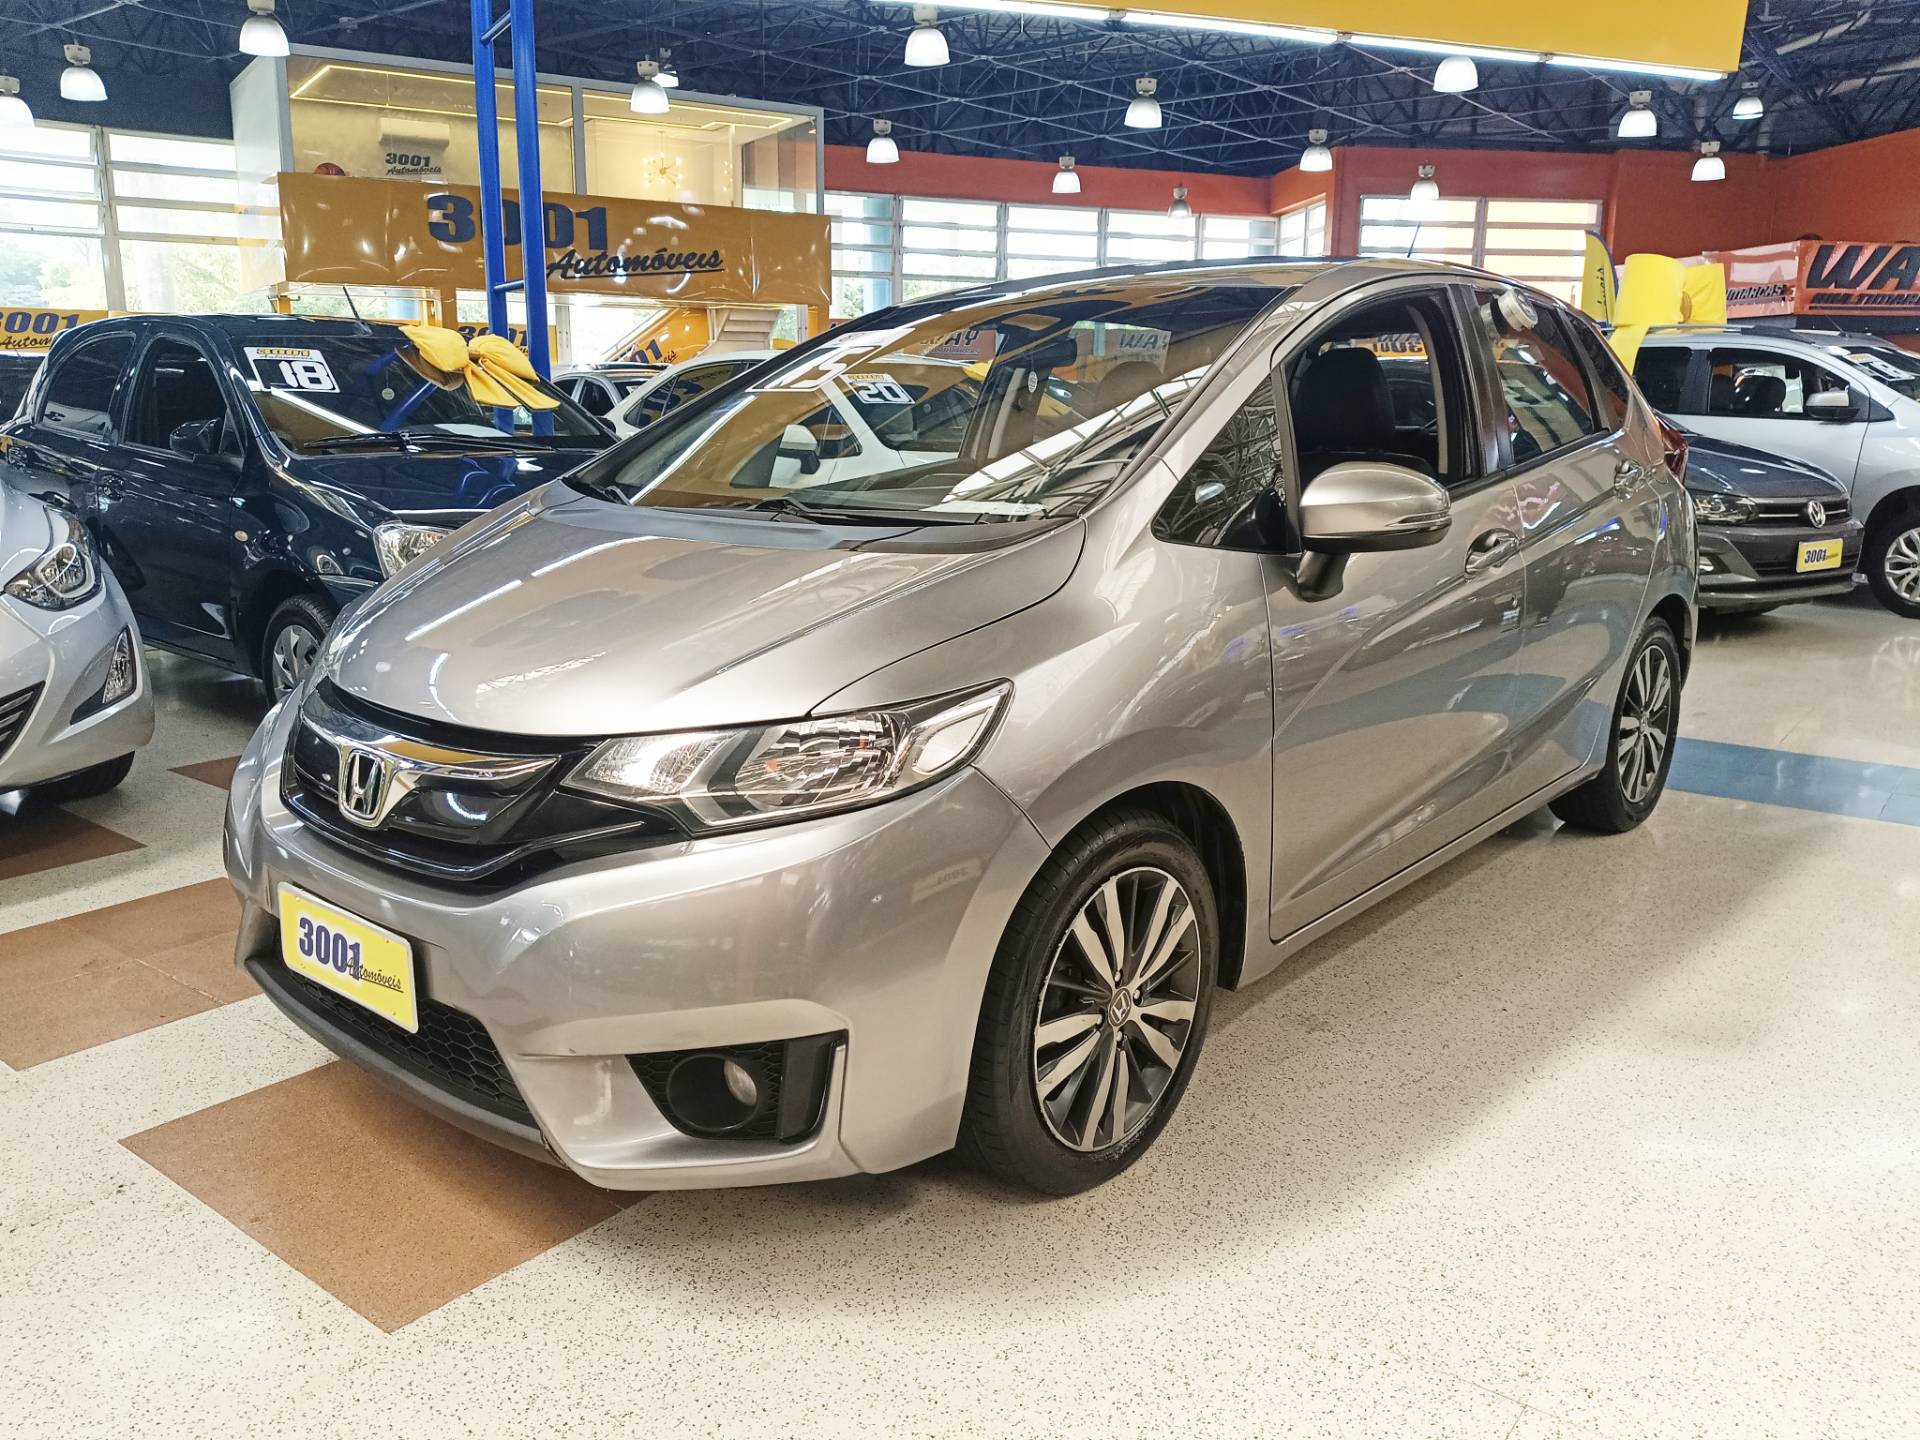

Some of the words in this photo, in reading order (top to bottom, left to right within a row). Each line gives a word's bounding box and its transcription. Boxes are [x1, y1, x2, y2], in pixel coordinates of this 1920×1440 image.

[385, 152, 431, 168] 3001
[545, 248, 724, 279] Automóveis
[0, 311, 79, 334] 001
[278, 360, 335, 390] 18
[856, 382, 912, 403] 20
[1804, 548, 1828, 564] 3001
[299, 917, 361, 981] 3001
